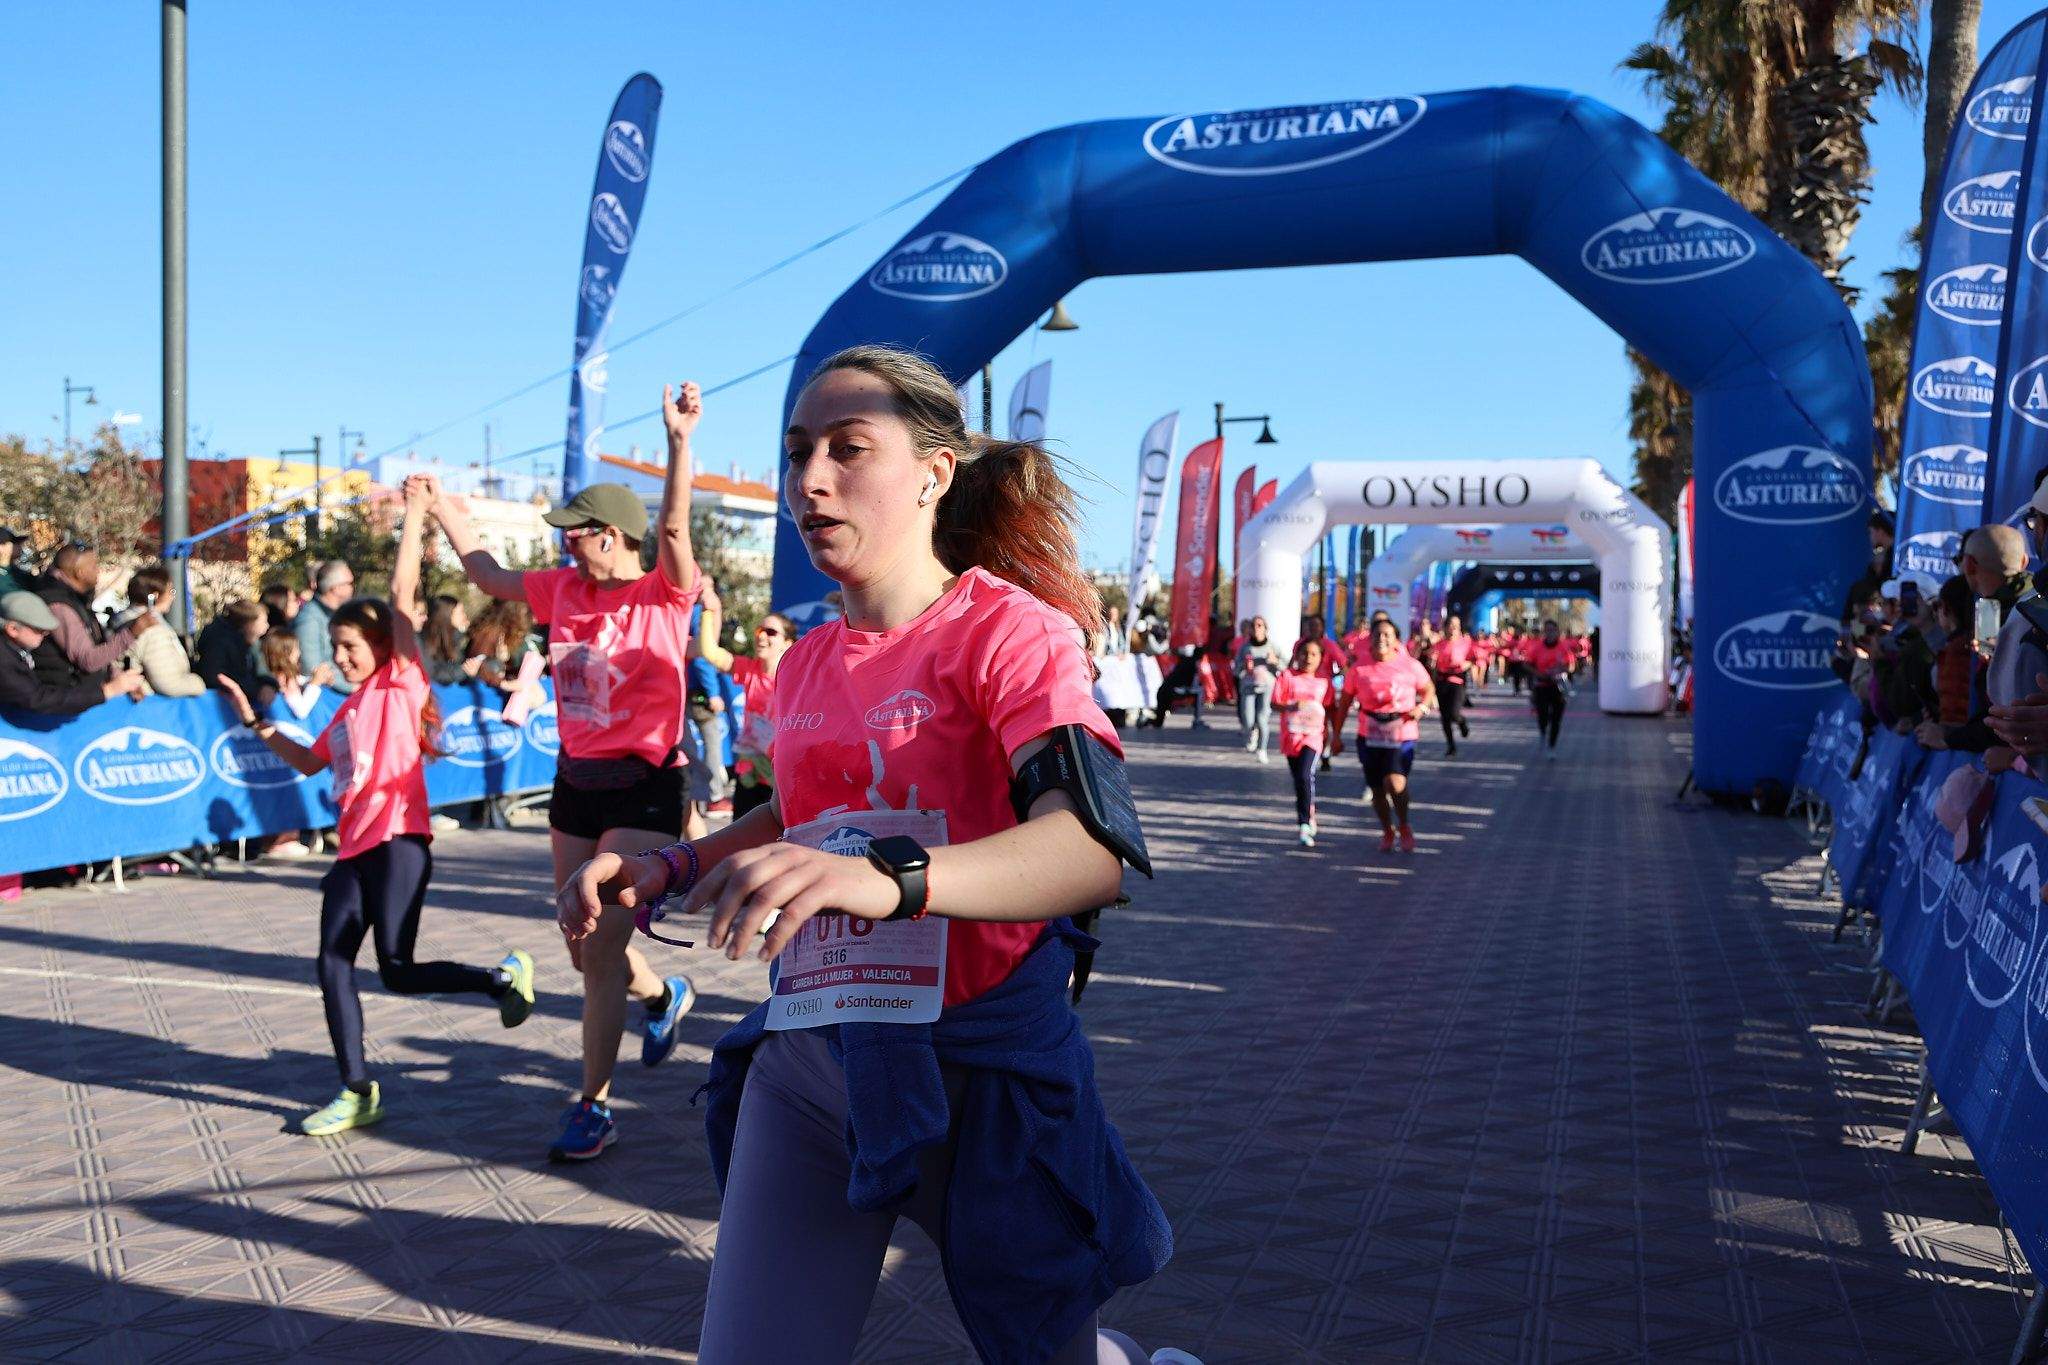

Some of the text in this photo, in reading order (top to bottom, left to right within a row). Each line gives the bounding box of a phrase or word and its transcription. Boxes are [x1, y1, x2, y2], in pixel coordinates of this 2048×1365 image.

[1973, 98, 2030, 124] ASTU
[1162, 103, 1401, 153] ASTURIANA
[1596, 239, 1744, 270] ASTURIANA
[879, 263, 995, 284] ASTURIANA
[1362, 473, 1530, 509] OYSHO
[1724, 477, 1858, 506] ASTURIANA
[868, 705, 930, 723] ASTURIANA
[87, 757, 199, 789] ASTURIANA
[822, 949, 847, 966] 6316
[791, 976, 814, 990] CARRERA
[829, 969, 853, 982] MUJER
[861, 968, 911, 981] VALENCIA
[787, 995, 914, 1017] OYSHO Santander
